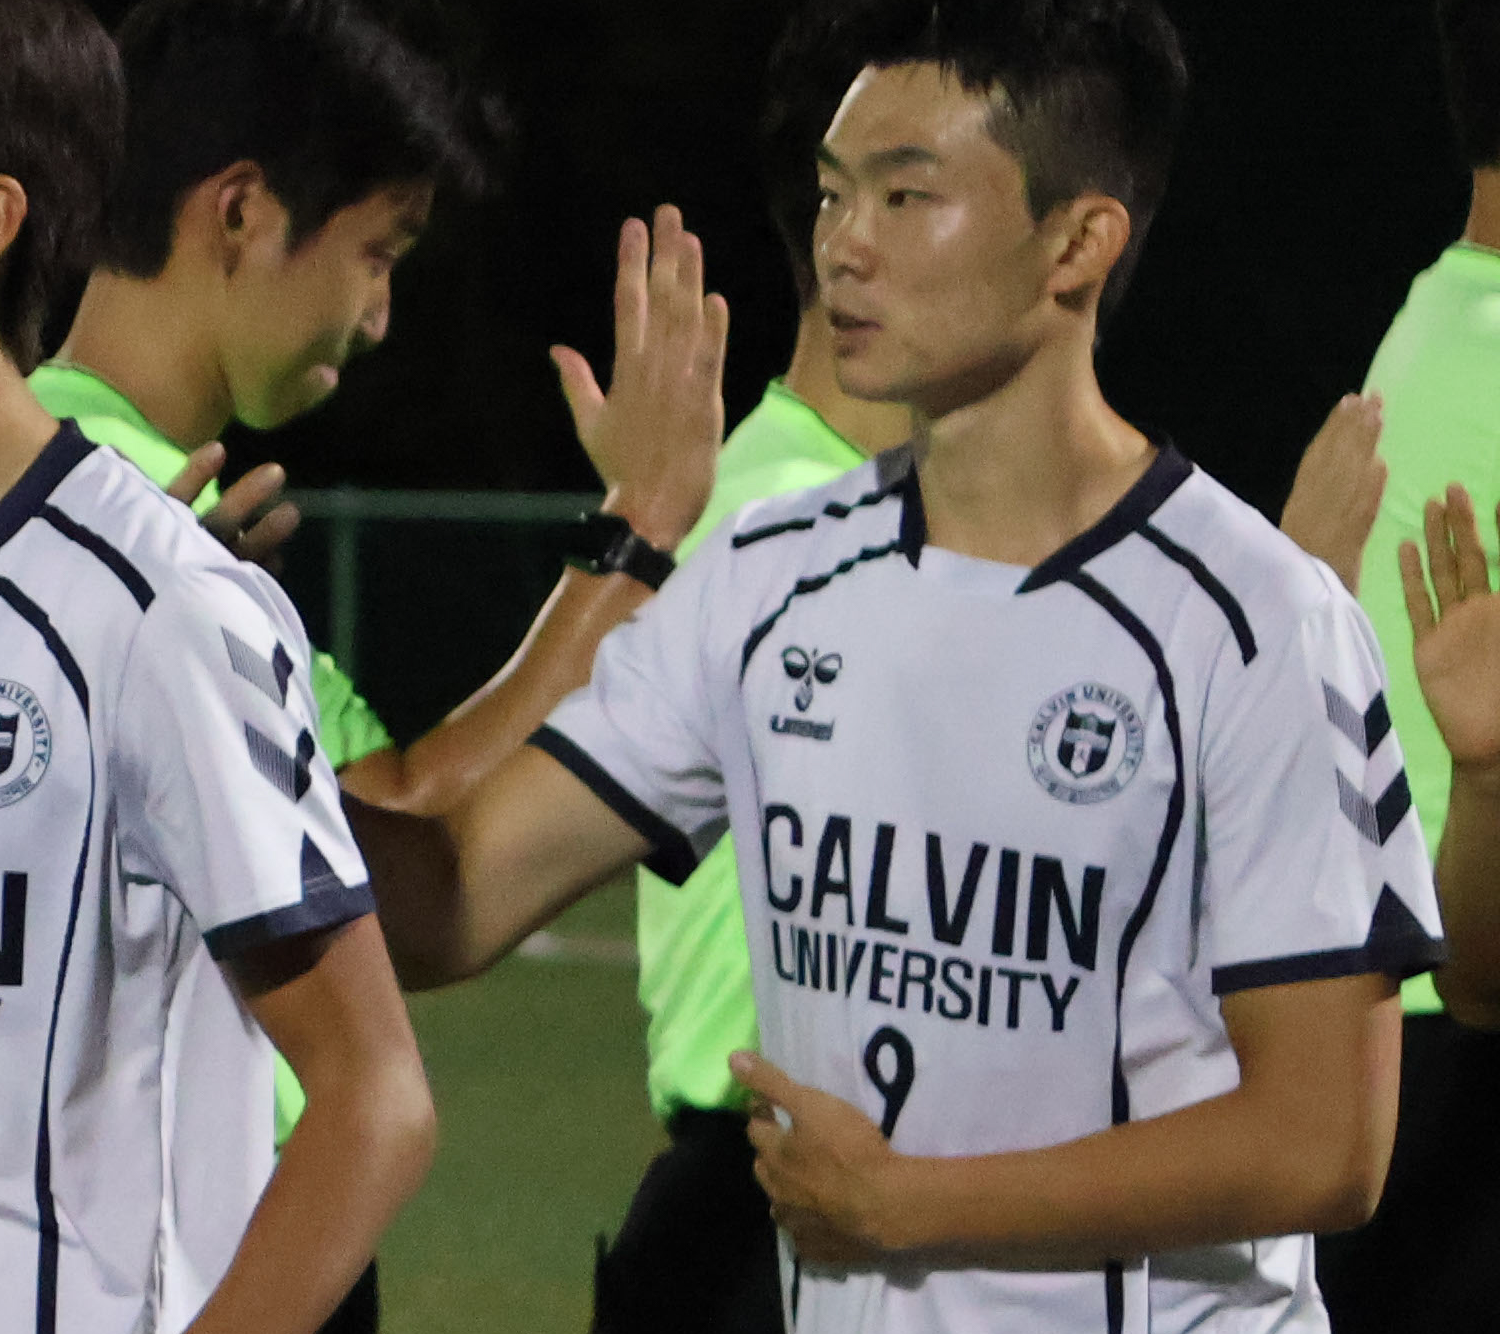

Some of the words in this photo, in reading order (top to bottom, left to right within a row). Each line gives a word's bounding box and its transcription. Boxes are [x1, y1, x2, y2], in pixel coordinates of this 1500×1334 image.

[762, 802, 1106, 972] CALVIN
[771, 920, 1080, 1032] UNIVERSITY
[862, 1025, 915, 1138] 9
